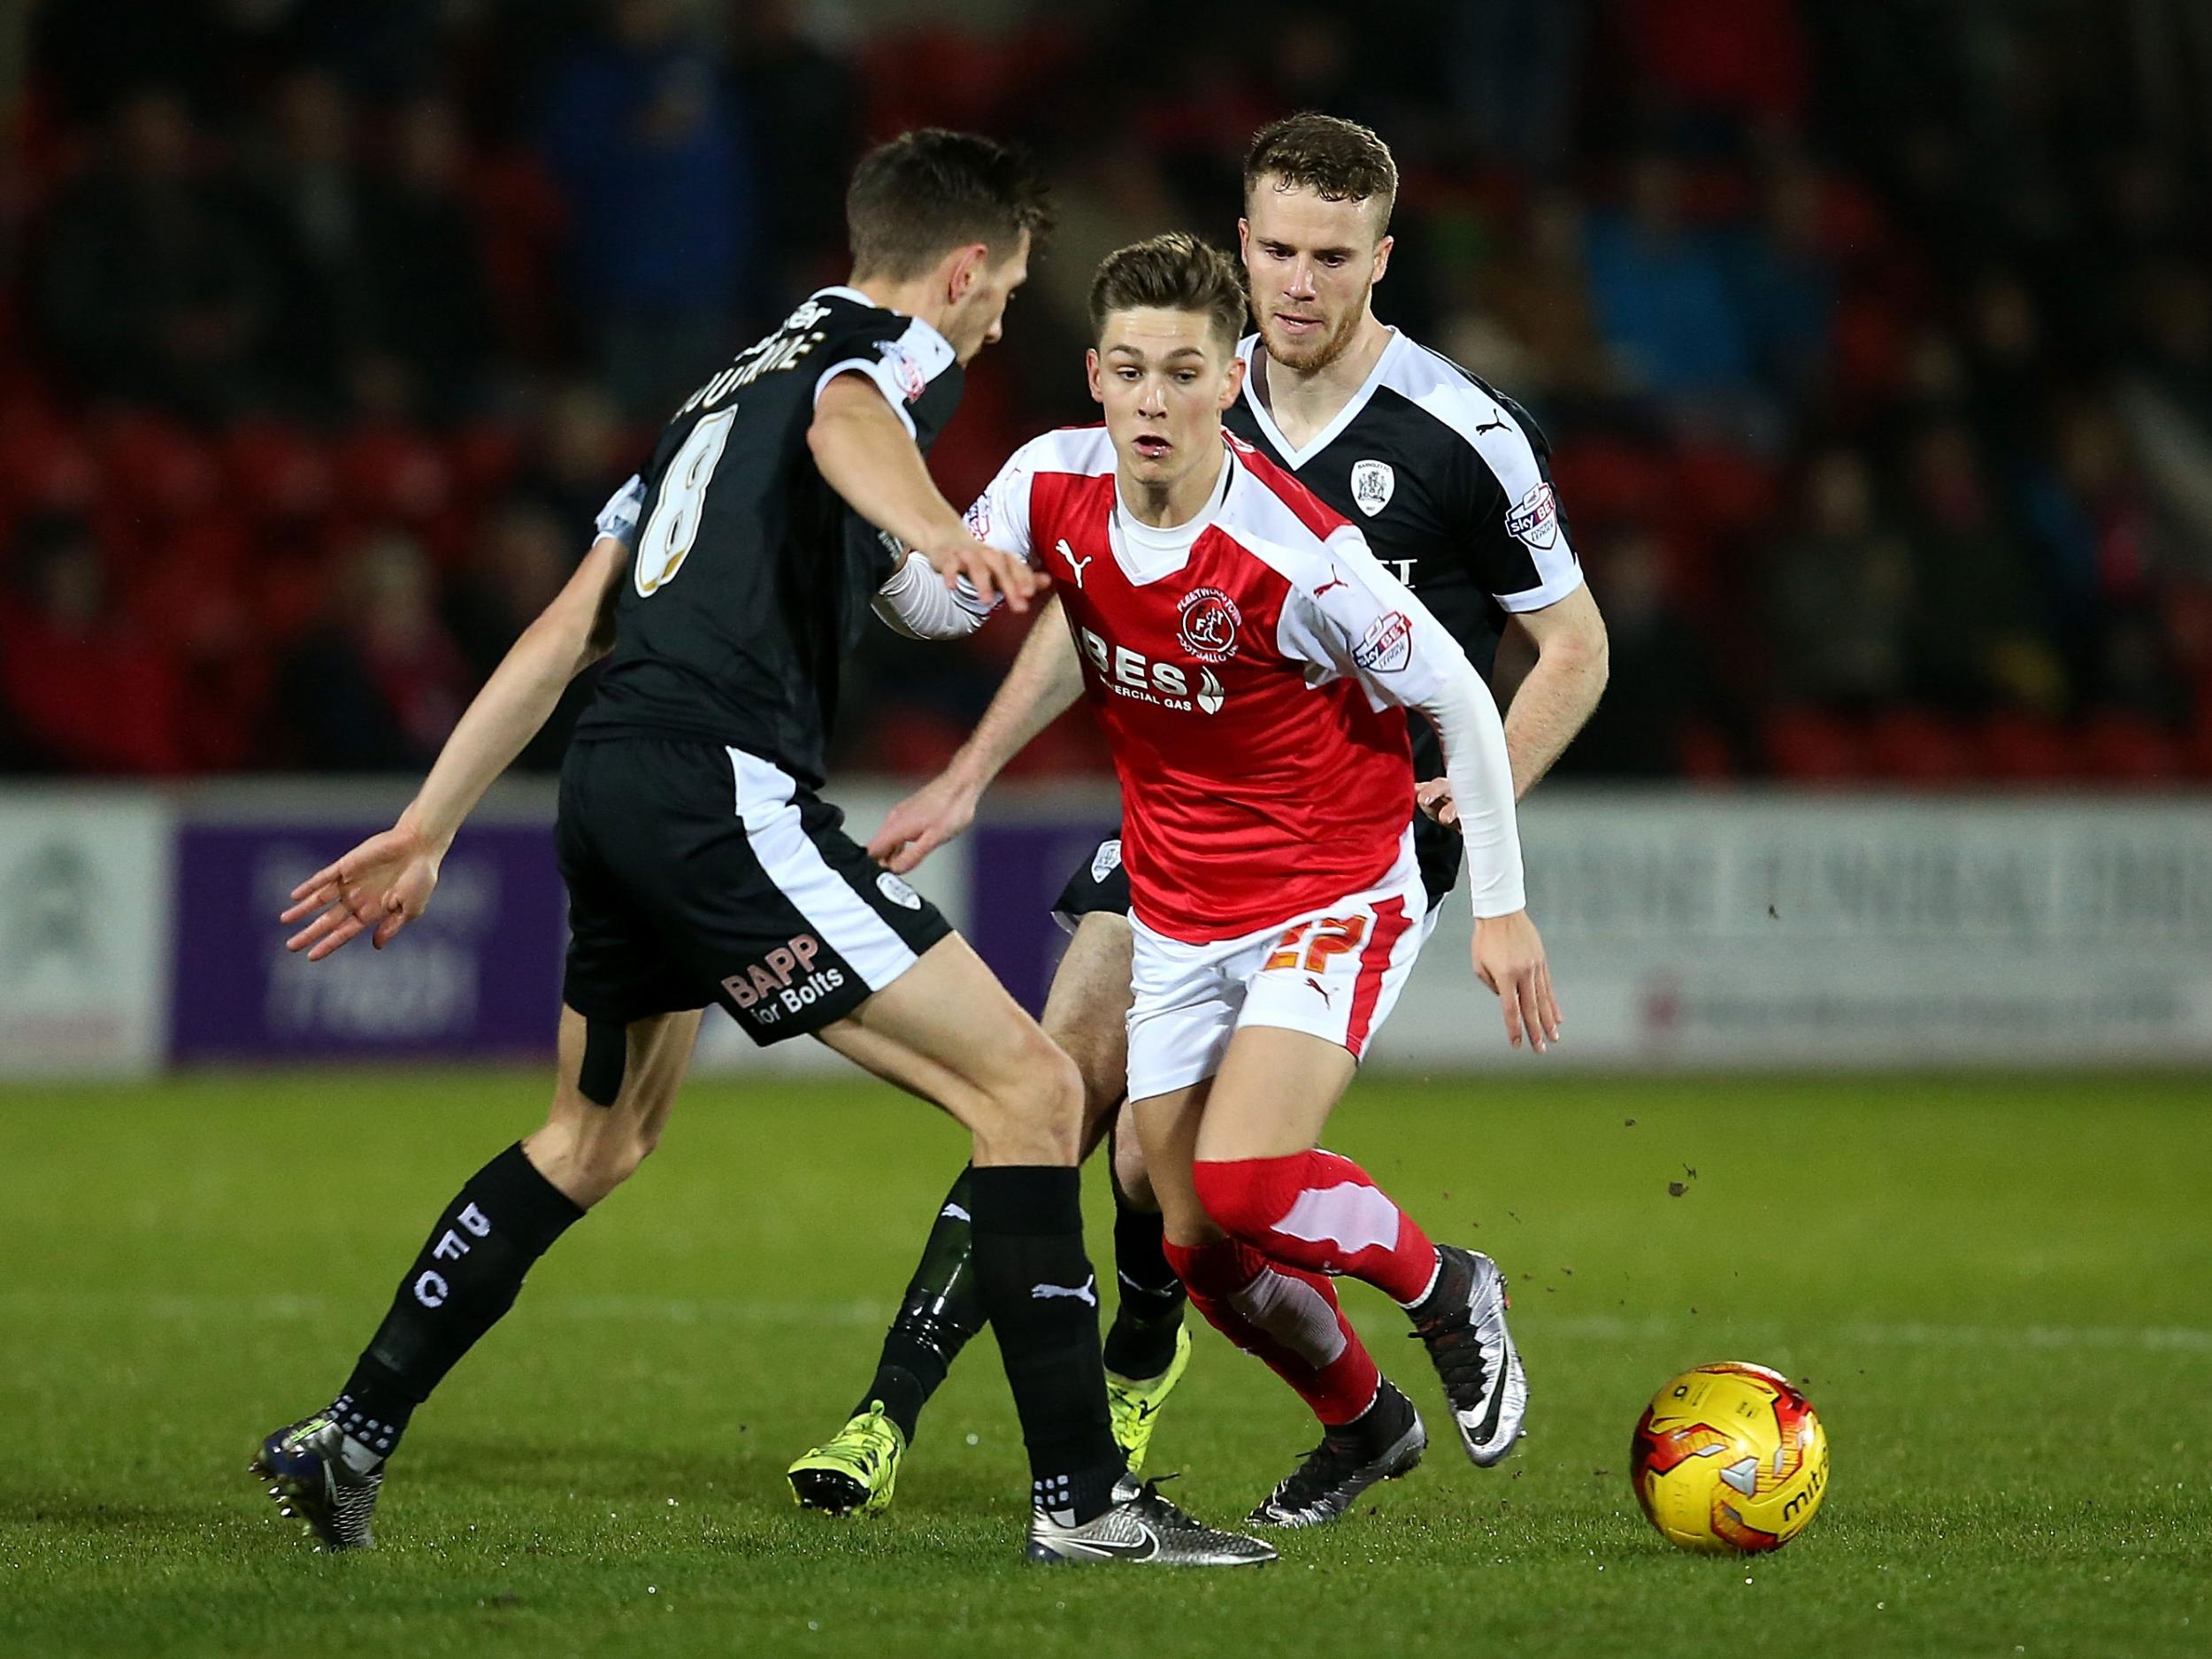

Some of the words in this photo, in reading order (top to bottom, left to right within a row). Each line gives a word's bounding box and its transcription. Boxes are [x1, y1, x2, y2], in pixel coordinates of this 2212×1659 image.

[634, 403, 739, 598] 8
[1164, 698, 1193, 711] GAS
[721, 933, 818, 1009] BAPP
[780, 968, 844, 1013] Bolts
